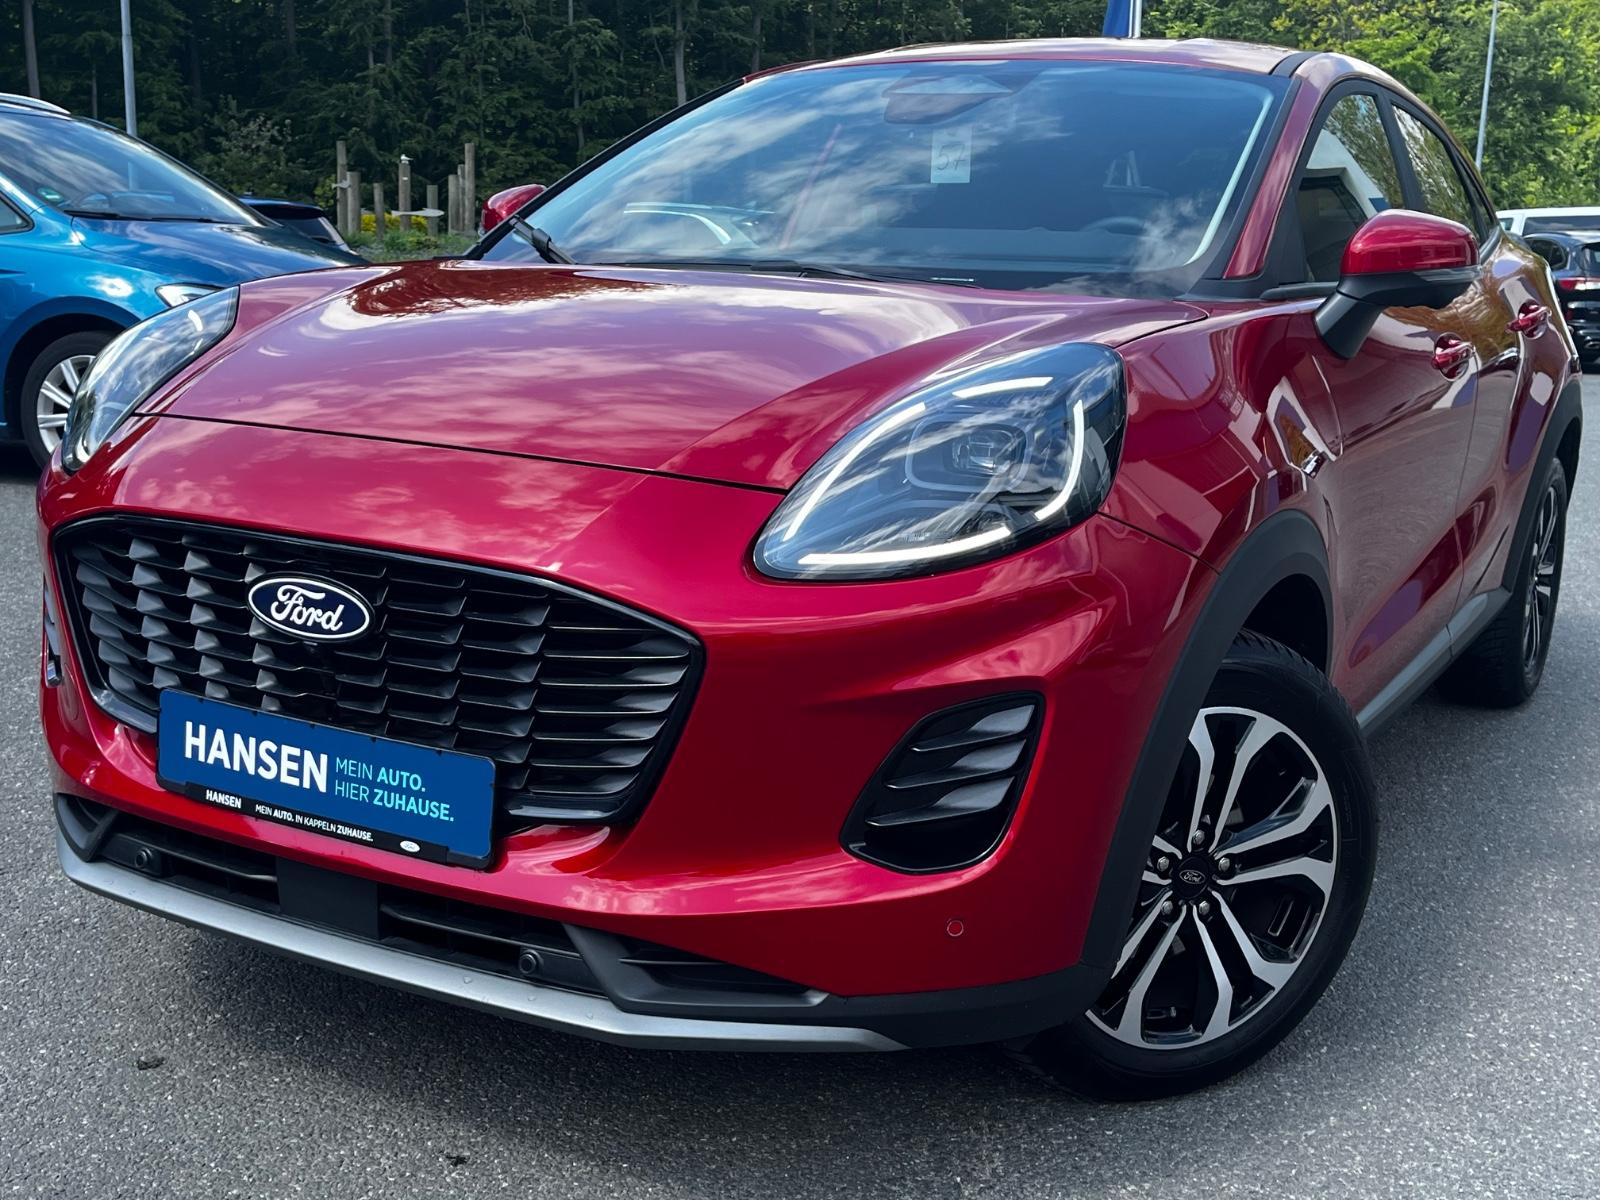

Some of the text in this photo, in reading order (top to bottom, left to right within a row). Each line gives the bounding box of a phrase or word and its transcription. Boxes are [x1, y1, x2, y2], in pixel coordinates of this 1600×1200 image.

[270, 584, 345, 632] Ford
[184, 720, 328, 793] HANSEN
[335, 756, 426, 793] MEIN AUTO.
[205, 789, 242, 809] HANSEN
[334, 779, 455, 822] HIER ZUHAUSE.
[255, 803, 374, 842] MEIN AUTO. IN KAPPELN ZUHAUSE.
